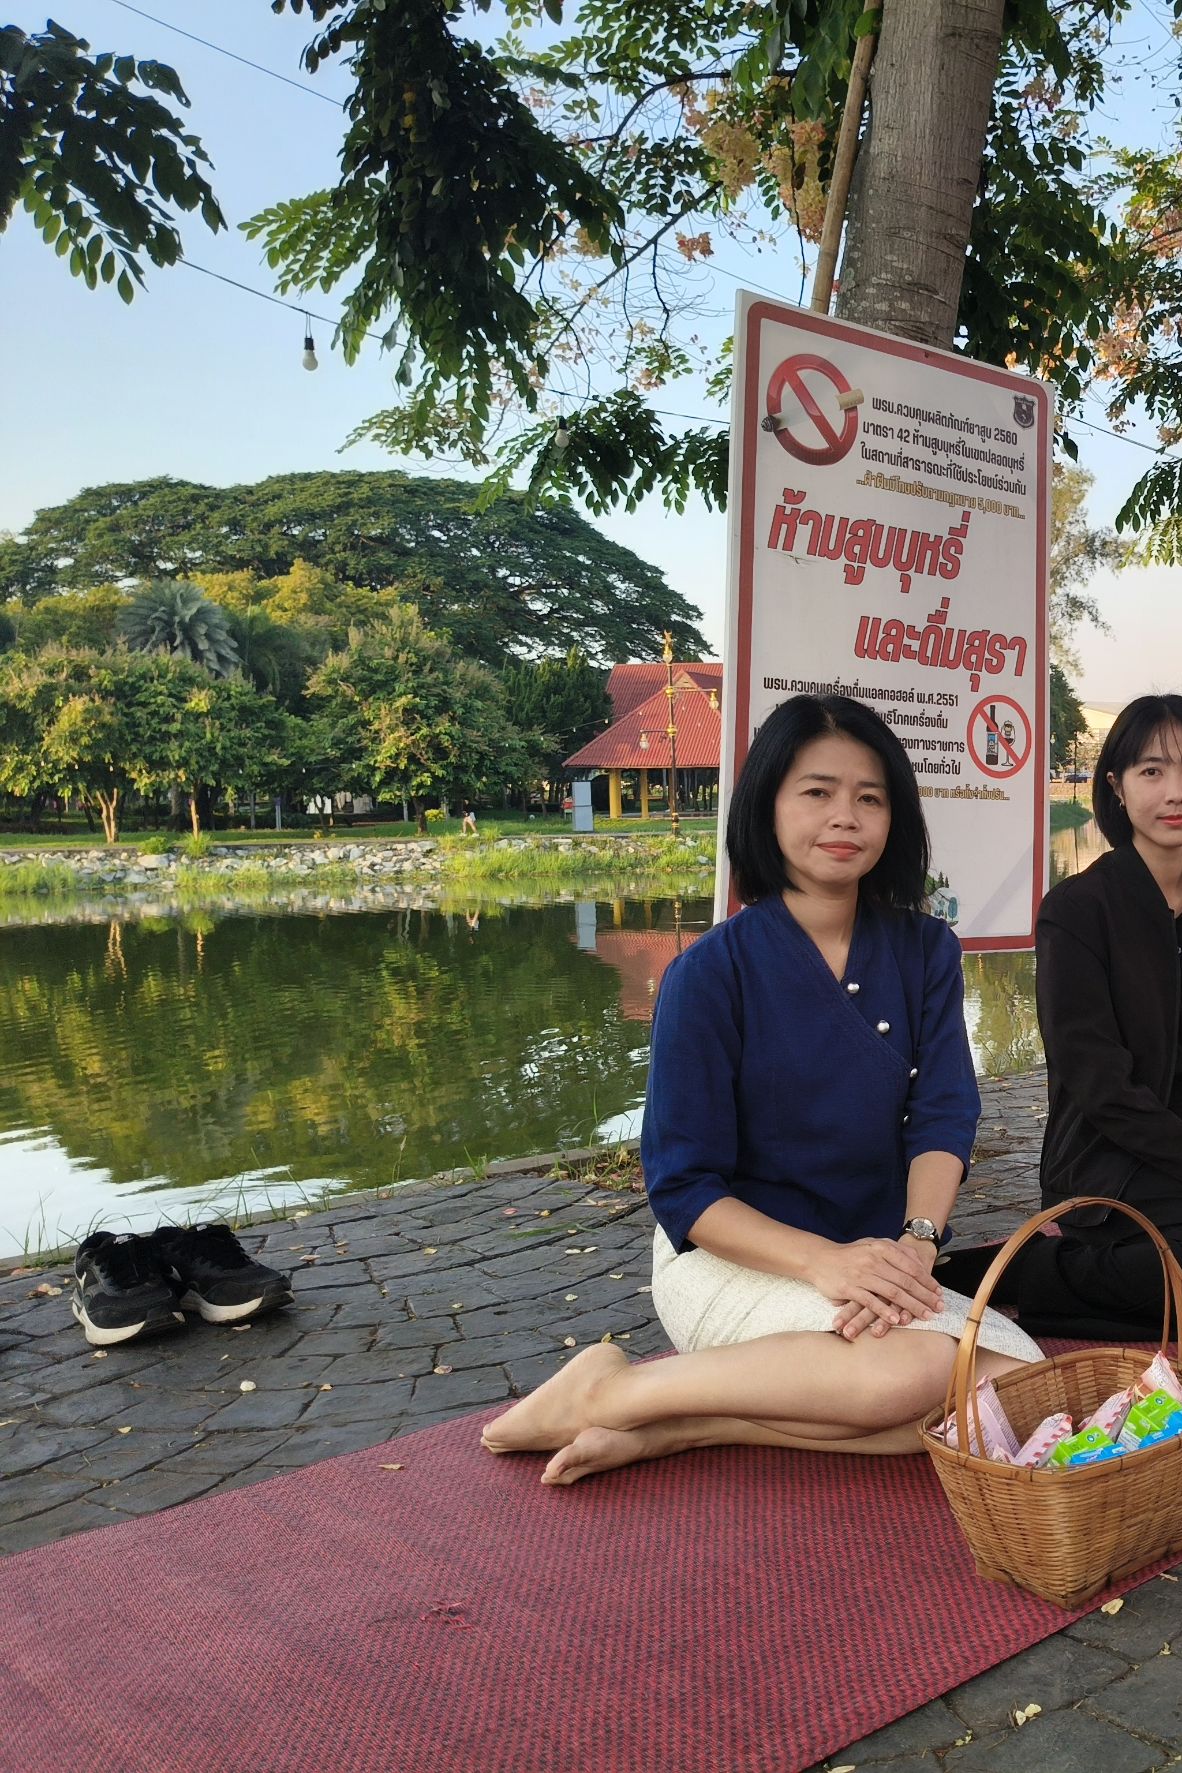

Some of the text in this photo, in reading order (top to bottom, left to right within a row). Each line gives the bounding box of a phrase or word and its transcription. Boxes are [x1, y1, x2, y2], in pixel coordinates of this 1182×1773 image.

[872, 397, 1018, 446] พรบ.ควบคุมผลิตภัณฑ์ยาสูบ 2560
[860, 442, 1027, 496] ในสถานที่สาธารณะที่ใช้ประโยชน์ร่วมกัน
[863, 421, 1025, 474] มาตรา 42 ห้ามสูบบุหรี่ในเขตปลอดบุหรี่
[977, 497, 1002, 515] 5,000
[767, 487, 971, 594] ห้ามสูบบุหรี่
[854, 596, 1028, 693] และดื่มสุรา
[763, 676, 959, 707] พรบ.ควบคมเครื่องดื่มแอลกอฮอล์ พ.ศ.2551
[897, 737, 966, 753] องทางราชการ
